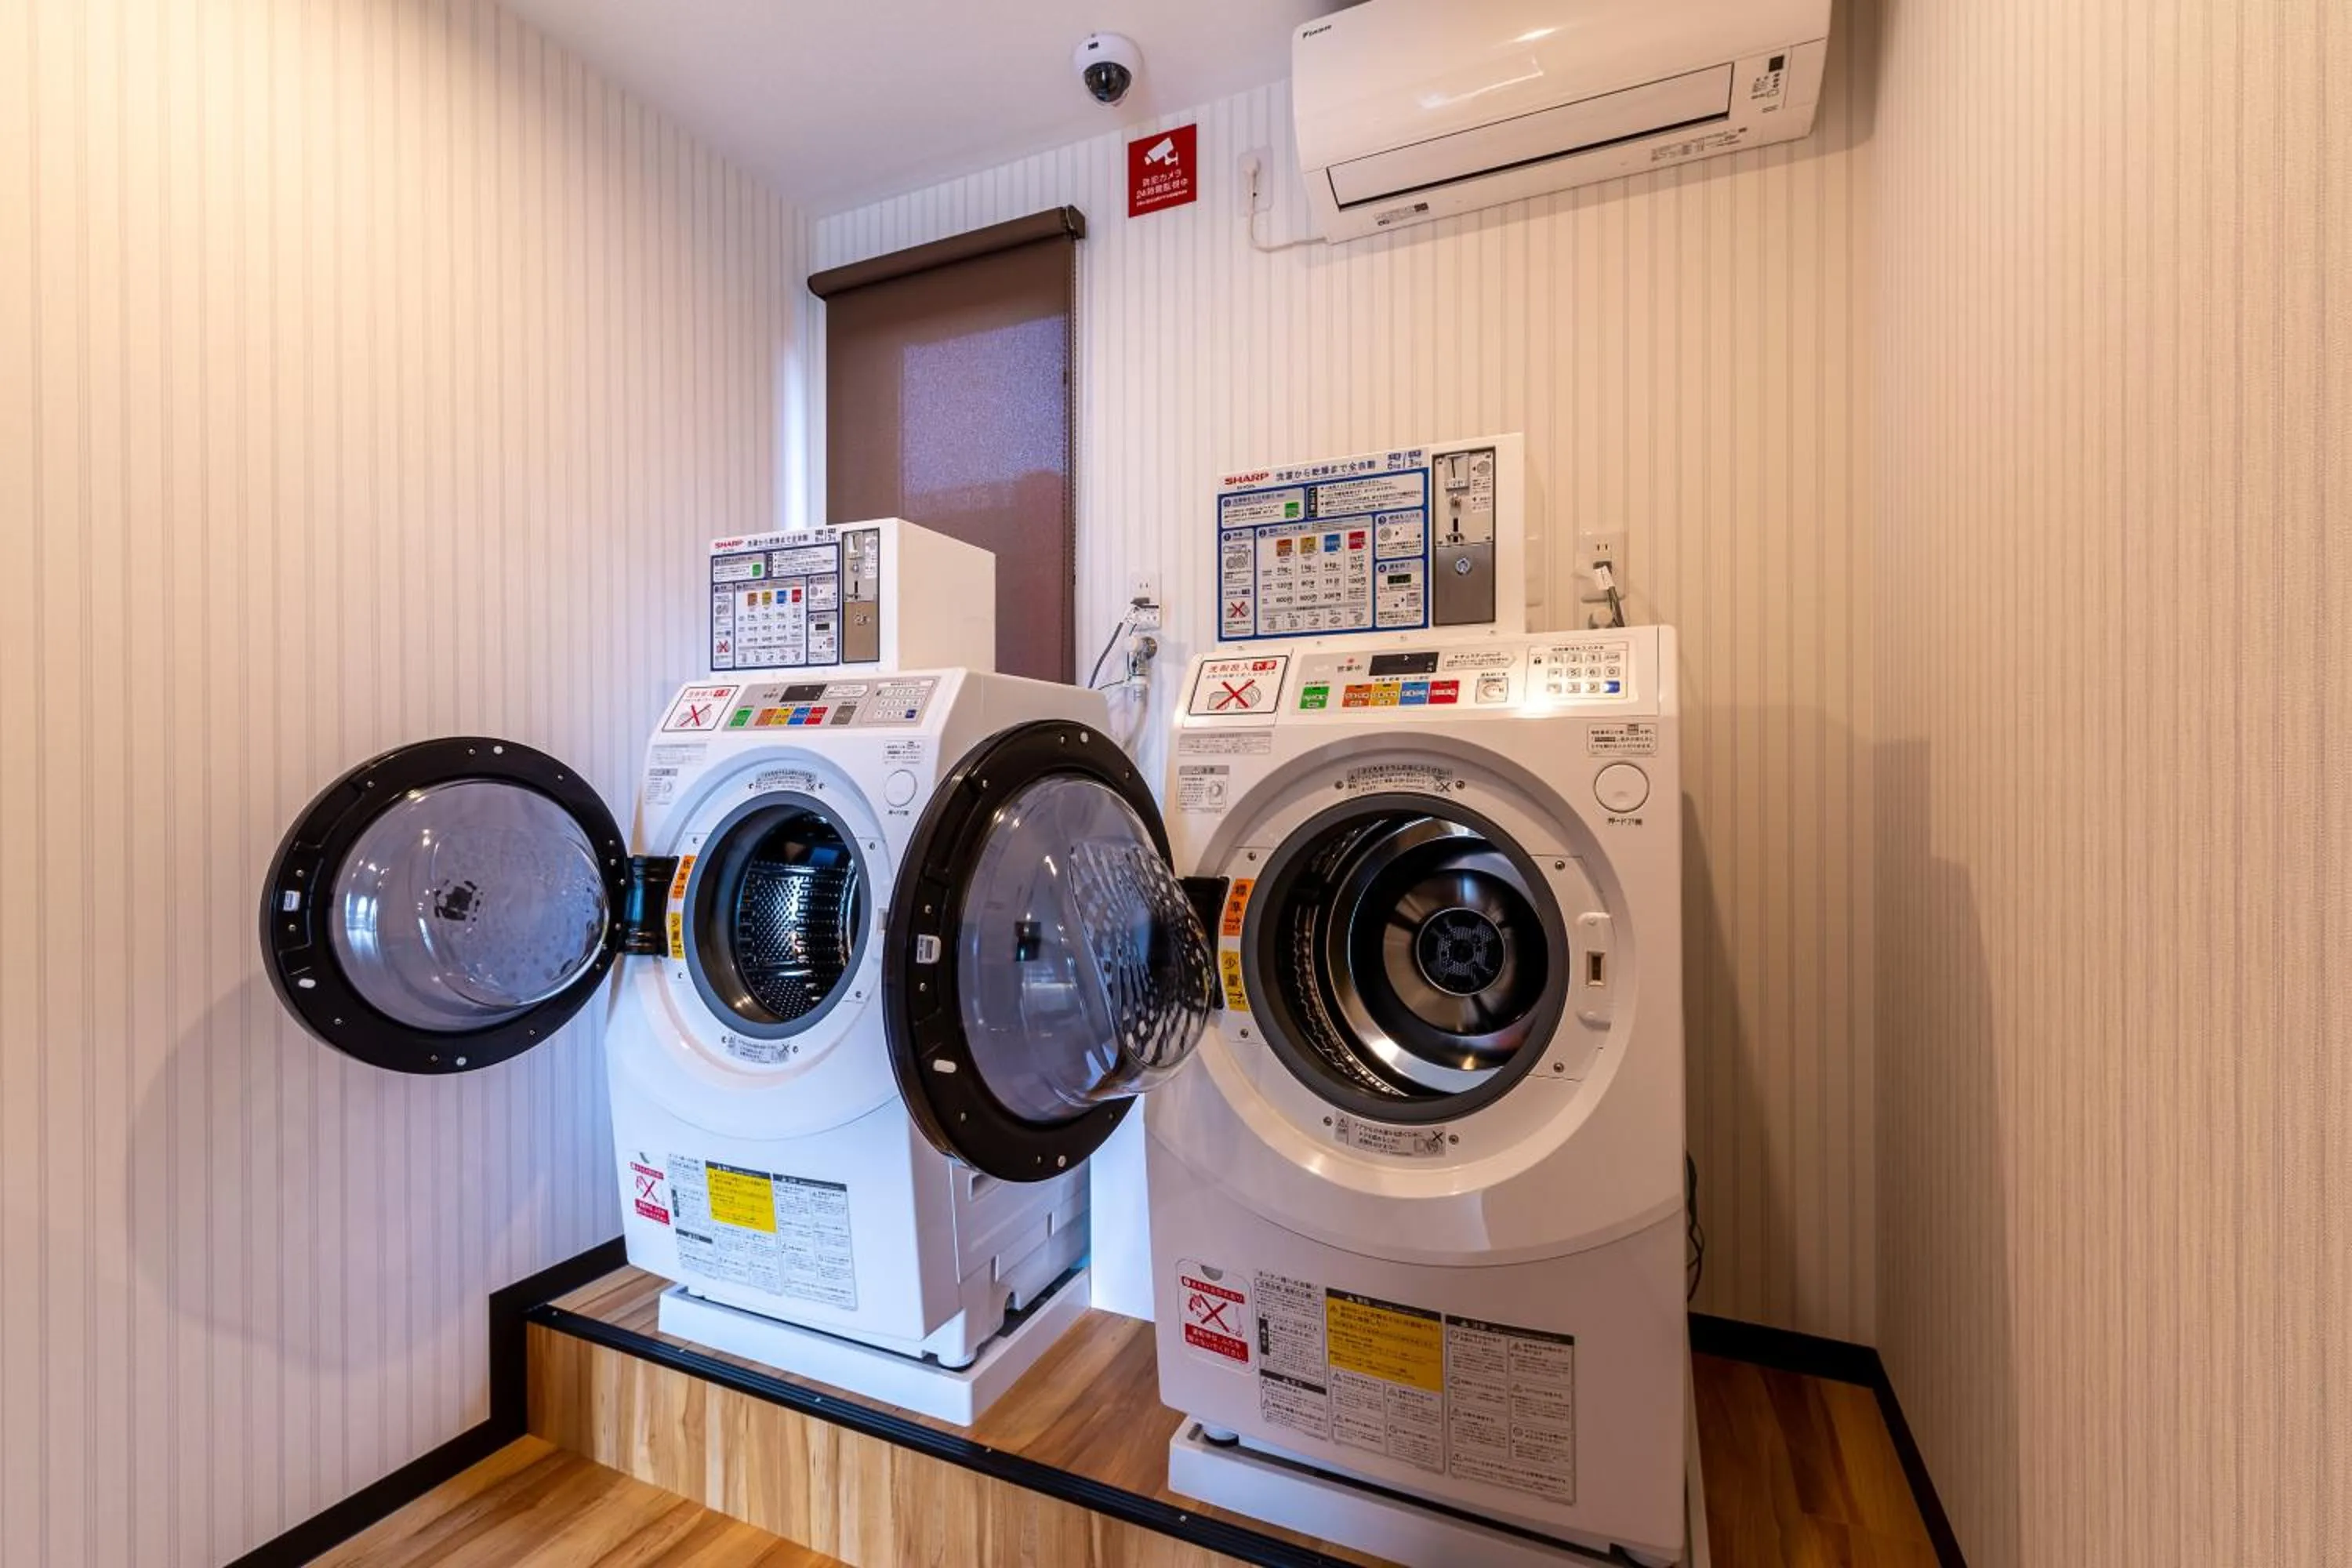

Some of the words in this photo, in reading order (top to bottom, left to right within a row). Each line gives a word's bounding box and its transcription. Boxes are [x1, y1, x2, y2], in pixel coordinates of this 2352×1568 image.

[1142, 169, 1181, 187] 防犯カメラ
[1224, 472, 1269, 485] SHARP
[714, 539, 745, 549] SHARP
